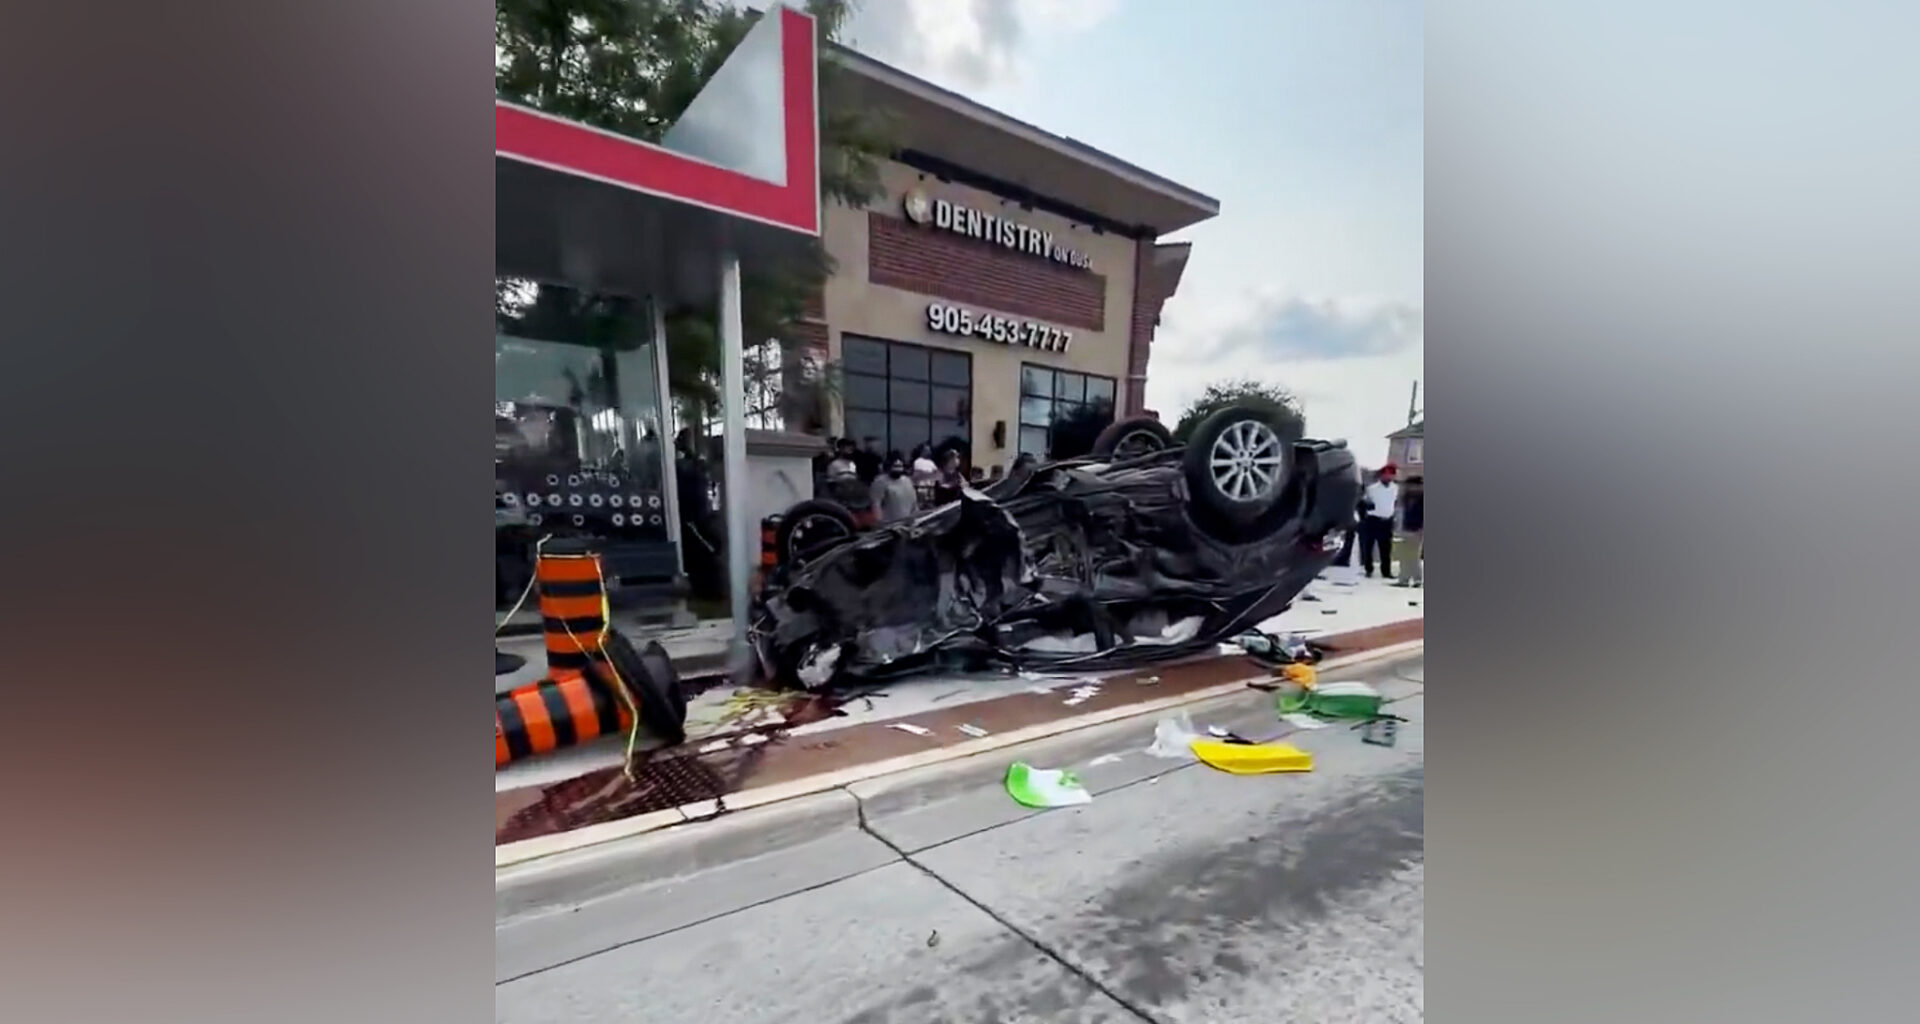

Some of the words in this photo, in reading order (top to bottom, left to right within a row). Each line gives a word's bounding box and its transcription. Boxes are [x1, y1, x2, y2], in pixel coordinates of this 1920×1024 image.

[935, 199, 1053, 257] DENTISTRY
[1054, 246, 1068, 263] ON
[928, 303, 1073, 353] 905-453-7777
